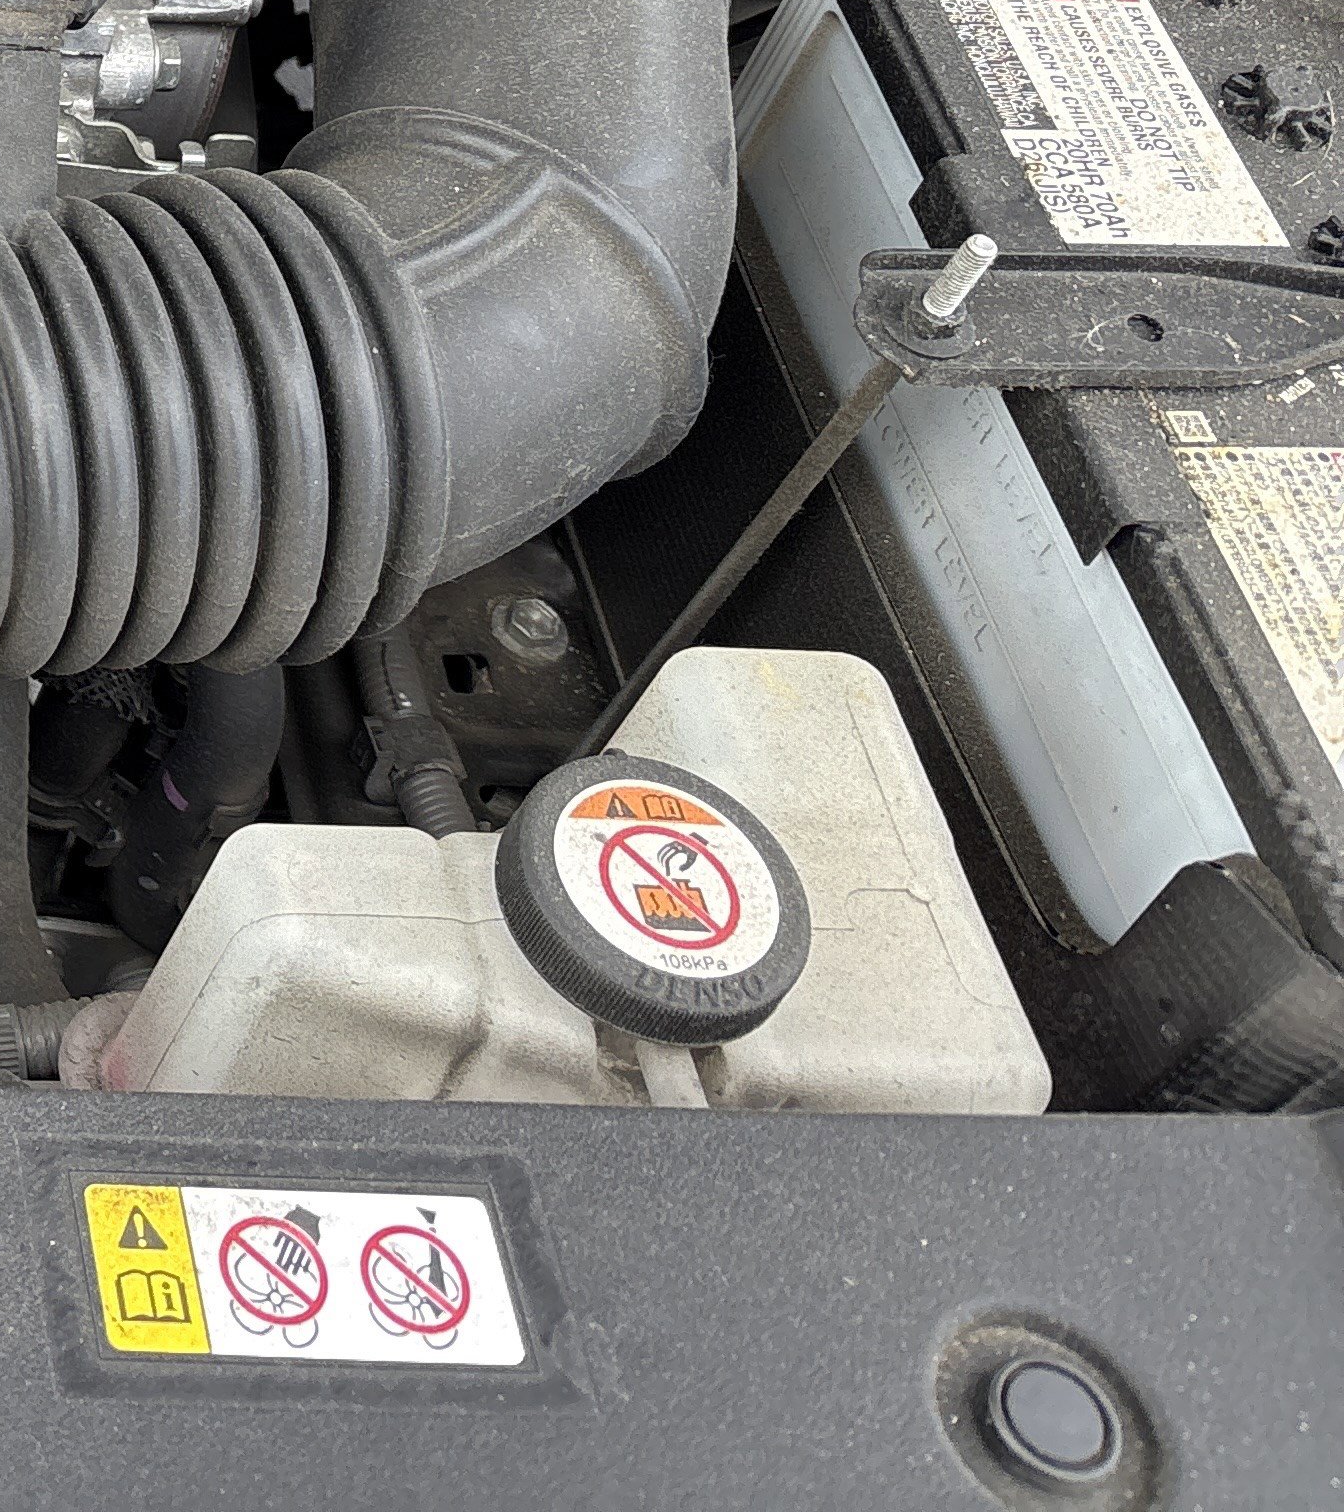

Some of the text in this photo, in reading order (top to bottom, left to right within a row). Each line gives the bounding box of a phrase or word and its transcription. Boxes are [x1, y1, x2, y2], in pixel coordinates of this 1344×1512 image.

[967, 23, 1004, 61] DIVISION
[1021, 25, 1061, 70] REACH
[1058, 4, 1101, 53] CAUSES
[1086, 55, 1129, 103] SEVERE
[1114, 105, 1156, 152] BURNS
[1122, 6, 1180, 79] EXPLOSIVE
[1166, 82, 1209, 128] GASES
[1047, 74, 1073, 92] OF
[1059, 95, 1114, 167] CHILDREN
[1127, 97, 1198, 192] DO NOT TIP
[1011, 137, 1073, 213] D26(JIS)
[1034, 137, 1106, 230] CCA 580A
[1059, 137, 1135, 239] 20HR 70Ah
[925, 535, 1002, 655] LEVEL
[634, 966, 767, 1010] DENSO
[659, 952, 729, 972] 108kPa
